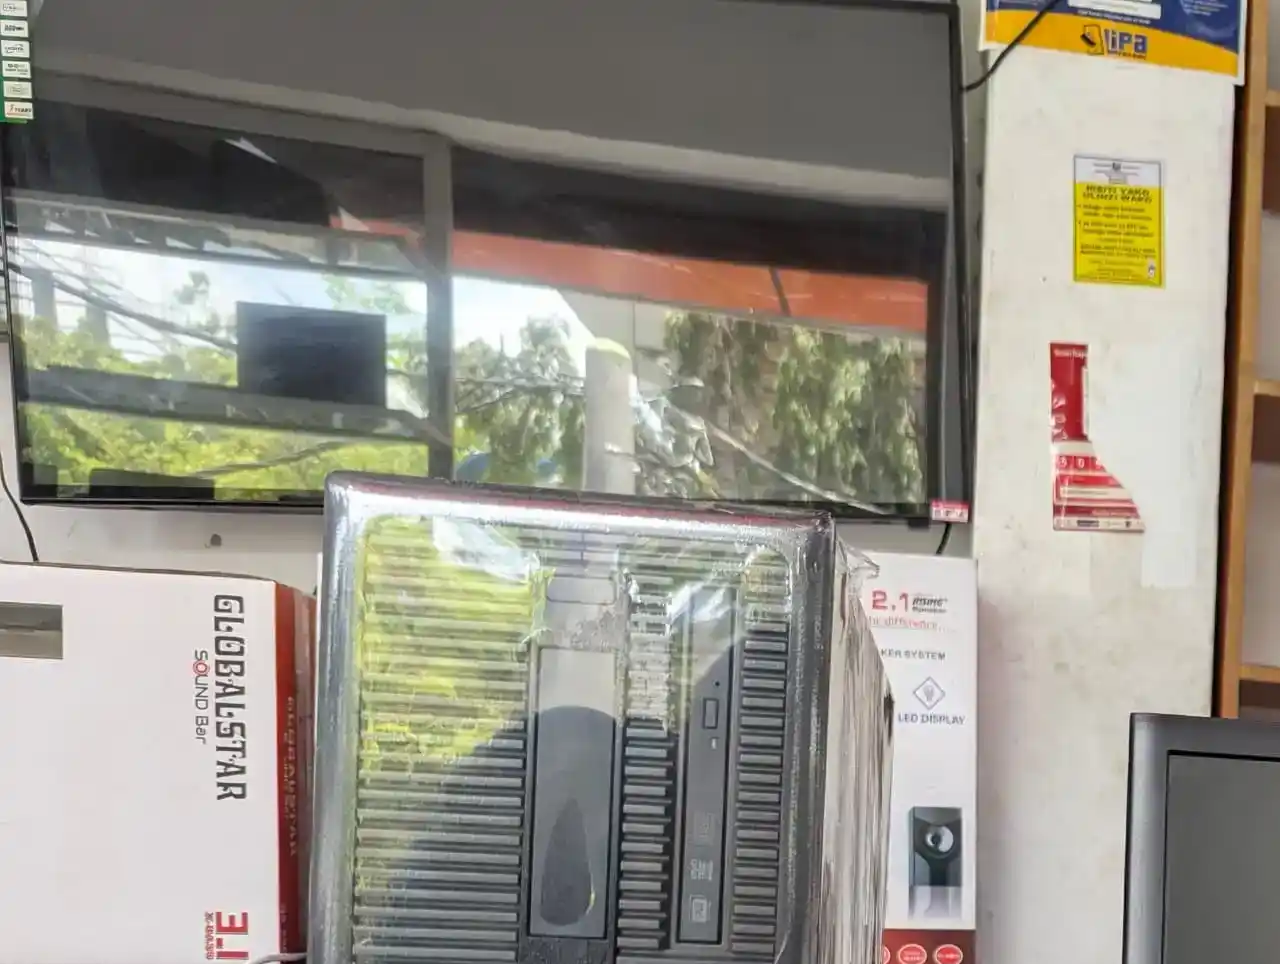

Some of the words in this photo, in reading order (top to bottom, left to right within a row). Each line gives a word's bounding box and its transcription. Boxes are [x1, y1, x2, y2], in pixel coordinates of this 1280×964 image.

[872, 590, 909, 613] 2.1
[904, 650, 946, 661] SYSTEM
[193, 649, 209, 711] SOUND
[213, 594, 247, 801] GLOBALSTAR
[195, 715, 209, 744] Bar
[898, 713, 918, 724] LED
[921, 714, 966, 725] DISPLAY
